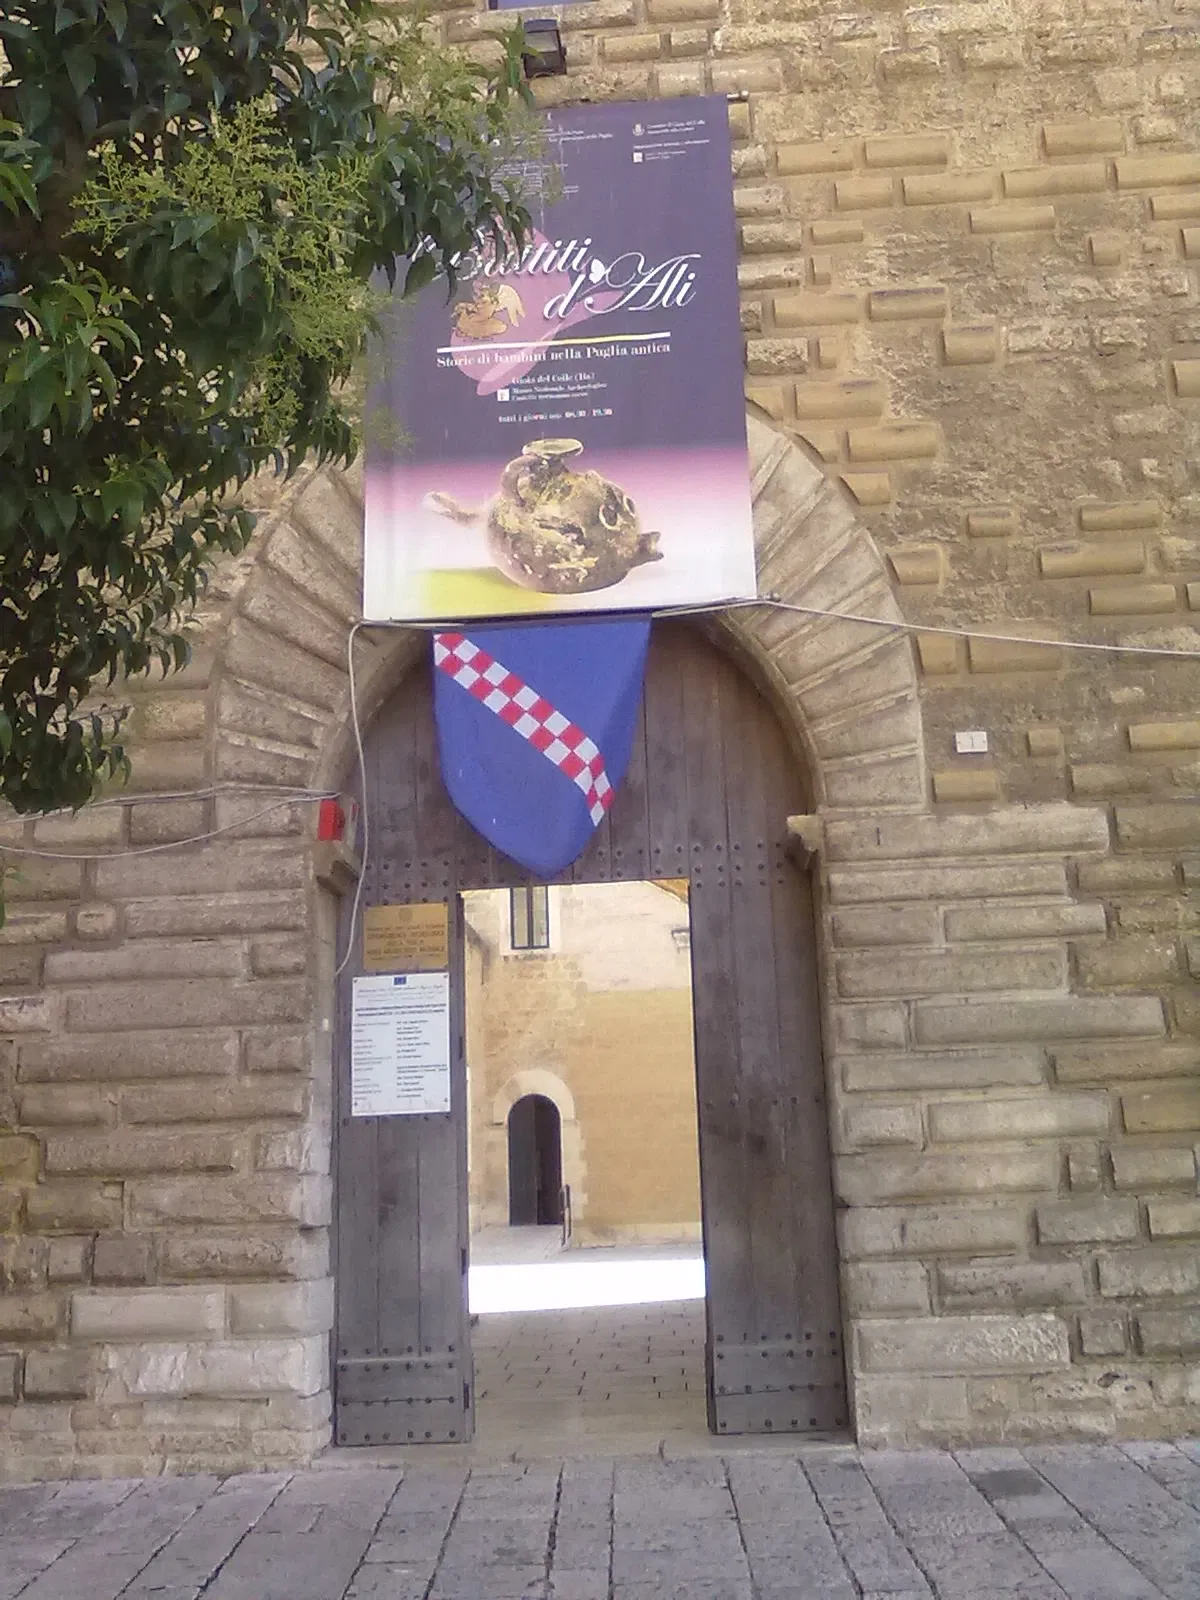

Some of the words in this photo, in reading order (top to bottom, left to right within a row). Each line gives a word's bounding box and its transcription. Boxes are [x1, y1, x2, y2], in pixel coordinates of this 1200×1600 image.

[437, 355, 473, 368] Storie
[478, 353, 490, 364] di
[551, 348, 582, 360] nella
[586, 344, 628, 359] Puglia
[631, 342, 671, 355] antica
